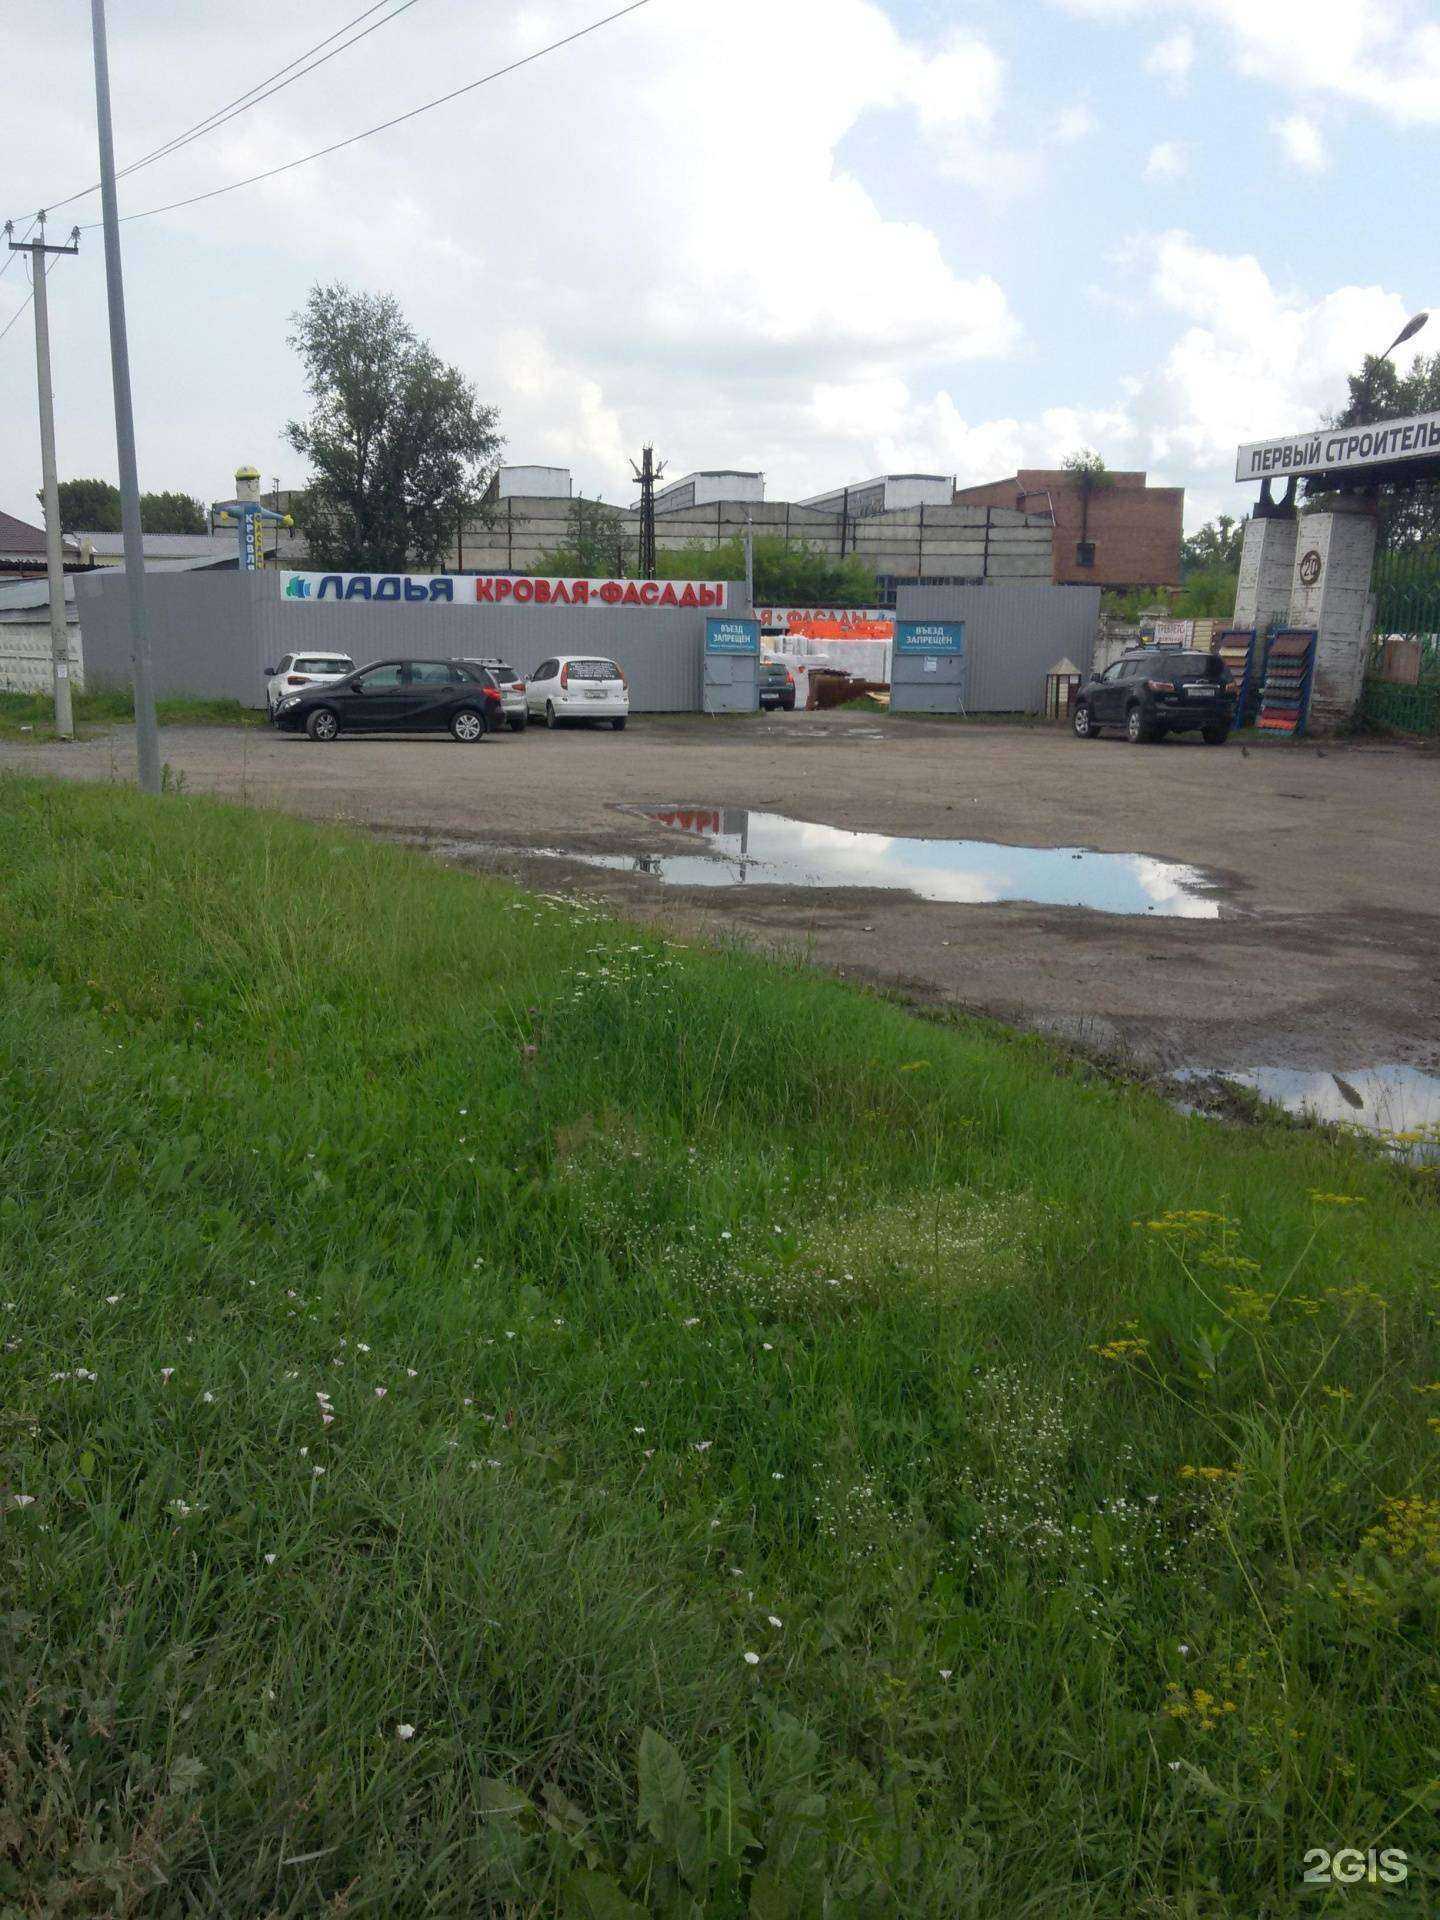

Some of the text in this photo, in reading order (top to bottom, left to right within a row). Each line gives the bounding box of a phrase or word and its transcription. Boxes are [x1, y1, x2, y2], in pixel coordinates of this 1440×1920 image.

[1251, 435, 1321, 472] ПЕРВЫЙ
[317, 575, 453, 600] ЛАДЬЯ
[720, 624, 744, 634] ВЪЕЗД
[915, 626, 944, 636] ВЪЕЗД
[713, 633, 751, 643] ЗАПРЕЩЕН
[906, 636, 953, 646] ЗАПРЕЩЕН
